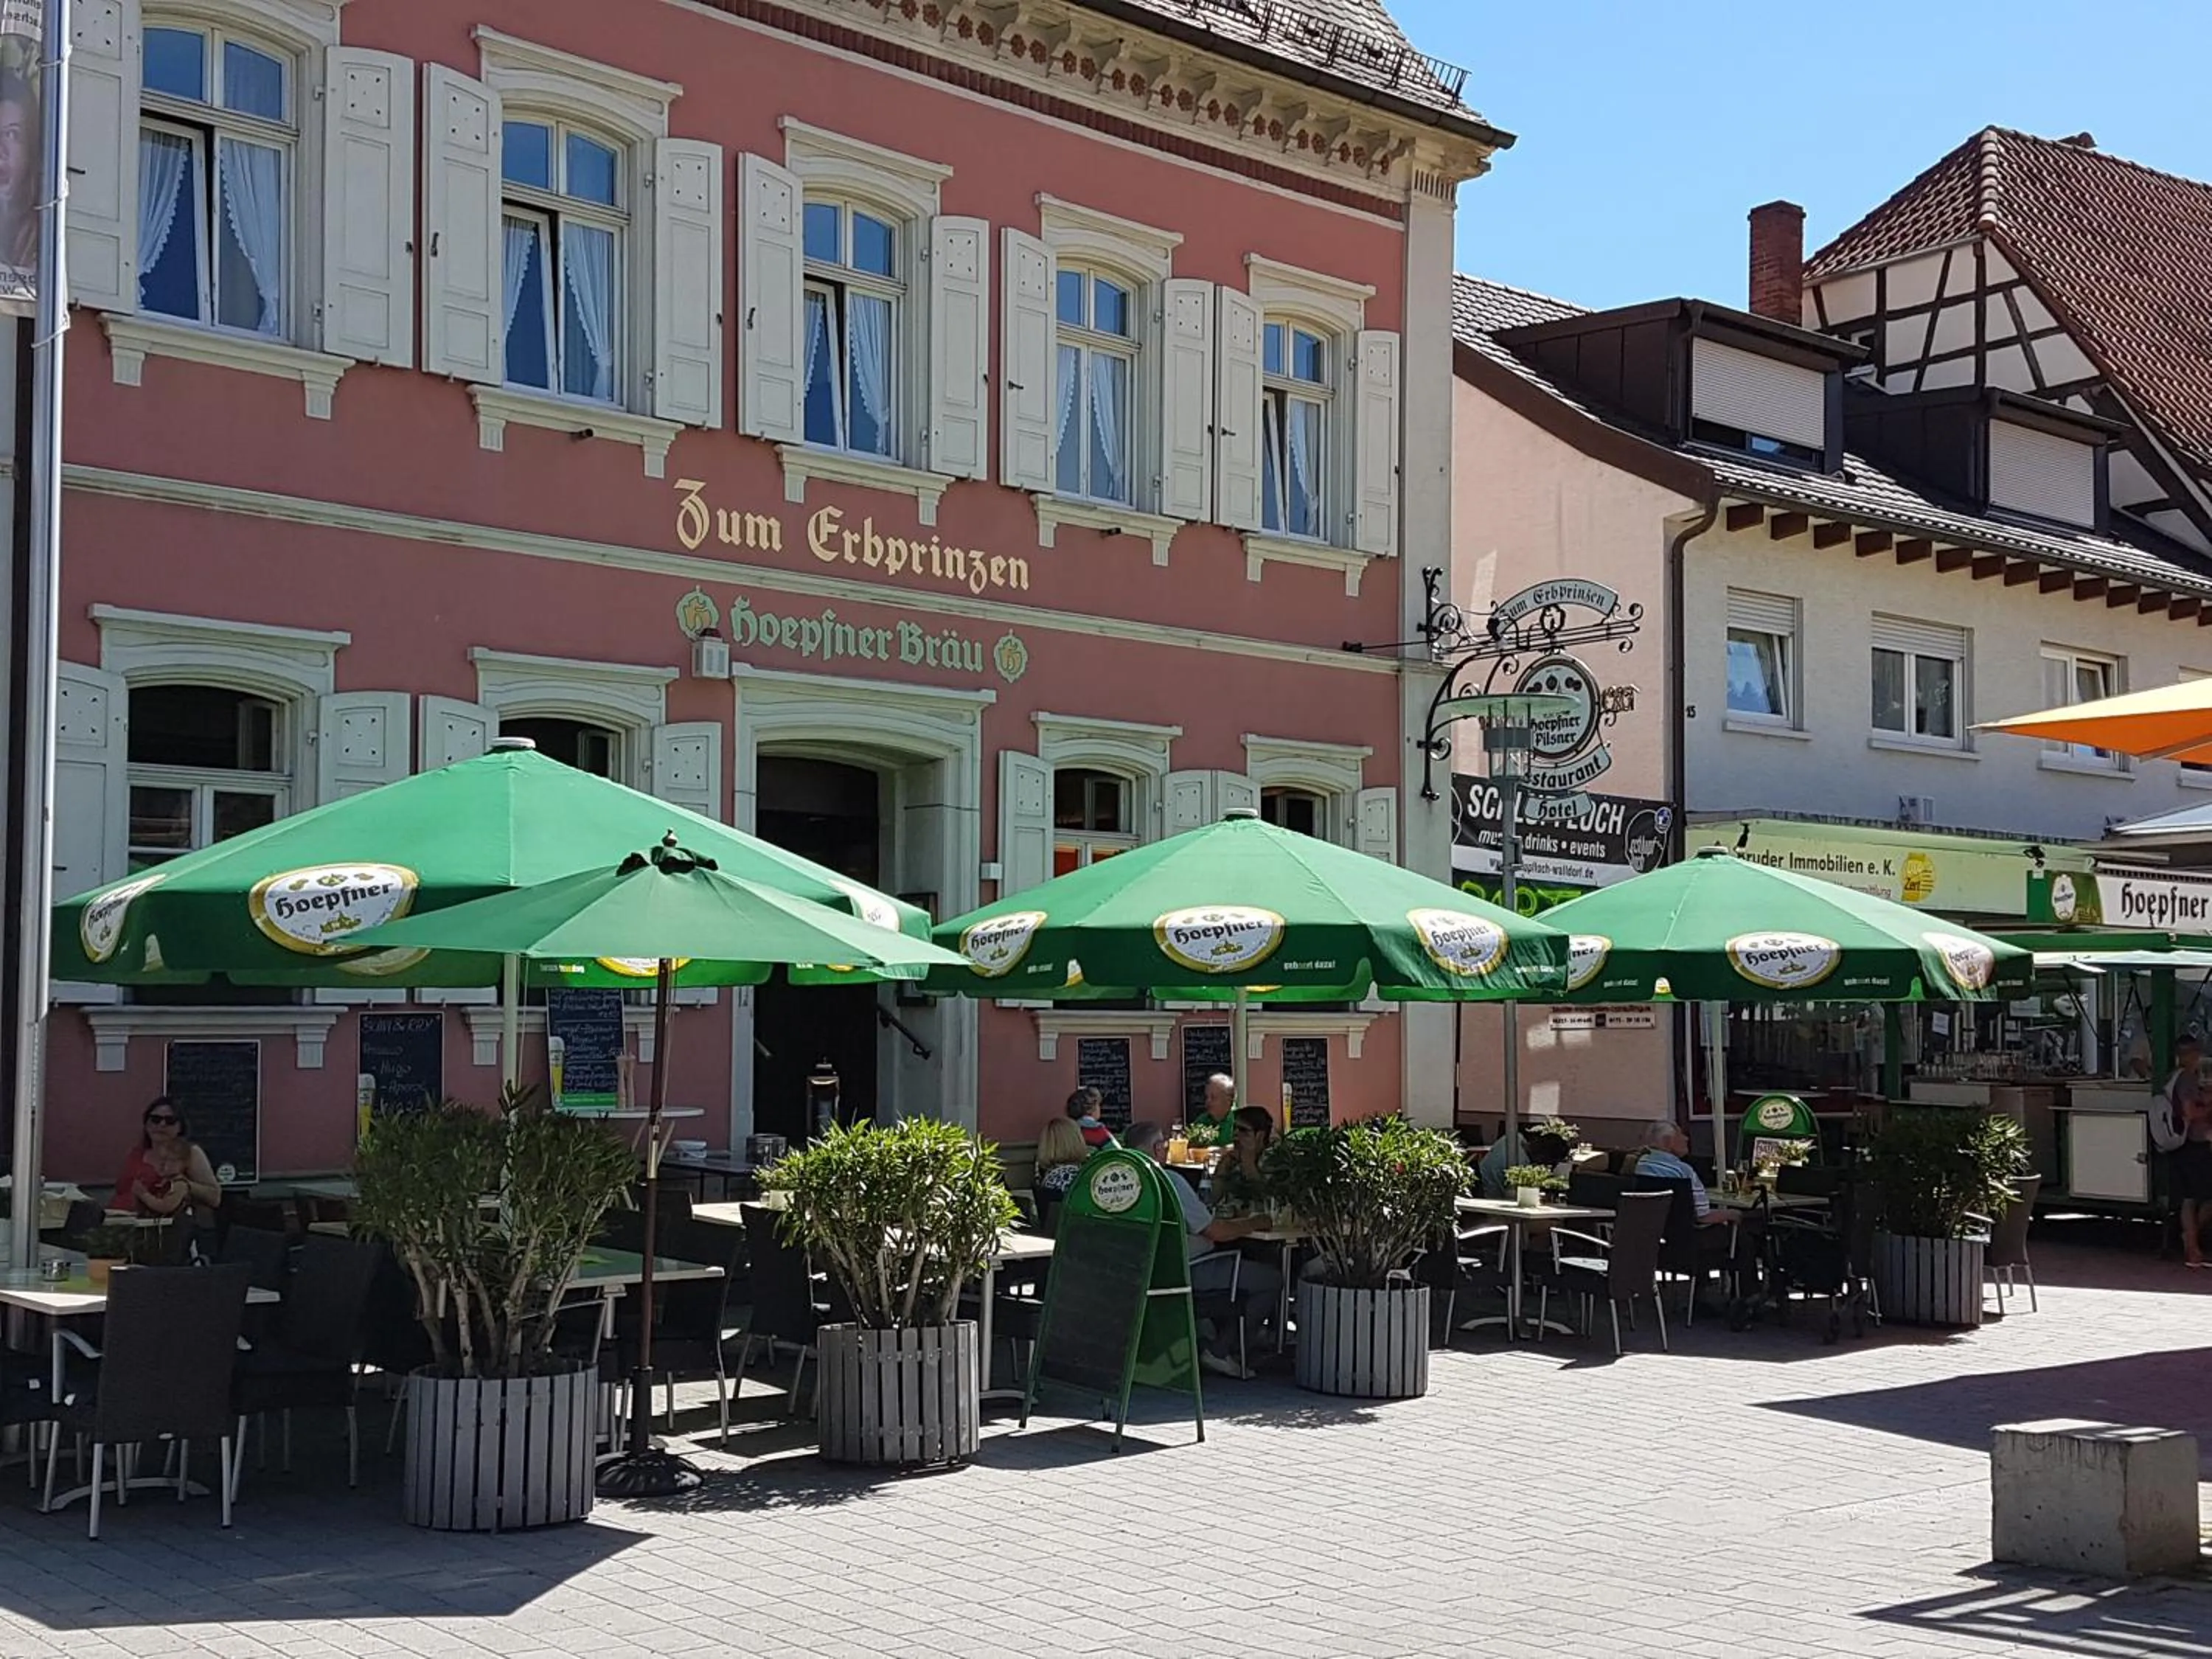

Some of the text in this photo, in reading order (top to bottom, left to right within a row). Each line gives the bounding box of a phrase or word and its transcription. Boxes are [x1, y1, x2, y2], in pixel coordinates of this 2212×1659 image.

[674, 478, 1030, 595] Zum Erbprinzen
[1499, 587, 1606, 625] Zum Erbprinzen
[731, 596, 984, 672] Hoepfner Bräu
[1535, 731, 1577, 747] Pilsner
[1523, 753, 1601, 787] staurant
[1525, 833, 1559, 853] drinks
[1570, 841, 1606, 858] events
[1790, 852, 1864, 874] Immobilien
[1867, 863, 1879, 875] e.
[1883, 859, 1896, 876] K.
[274, 883, 394, 919] Hoepfner
[2121, 882, 2210, 925] Hoepfner
[970, 925, 1028, 950] Hoepfner
[1173, 919, 1264, 945] Hoepfner
[1431, 925, 1490, 947] Hoepfner
[1745, 943, 1821, 967] Hoepfner
